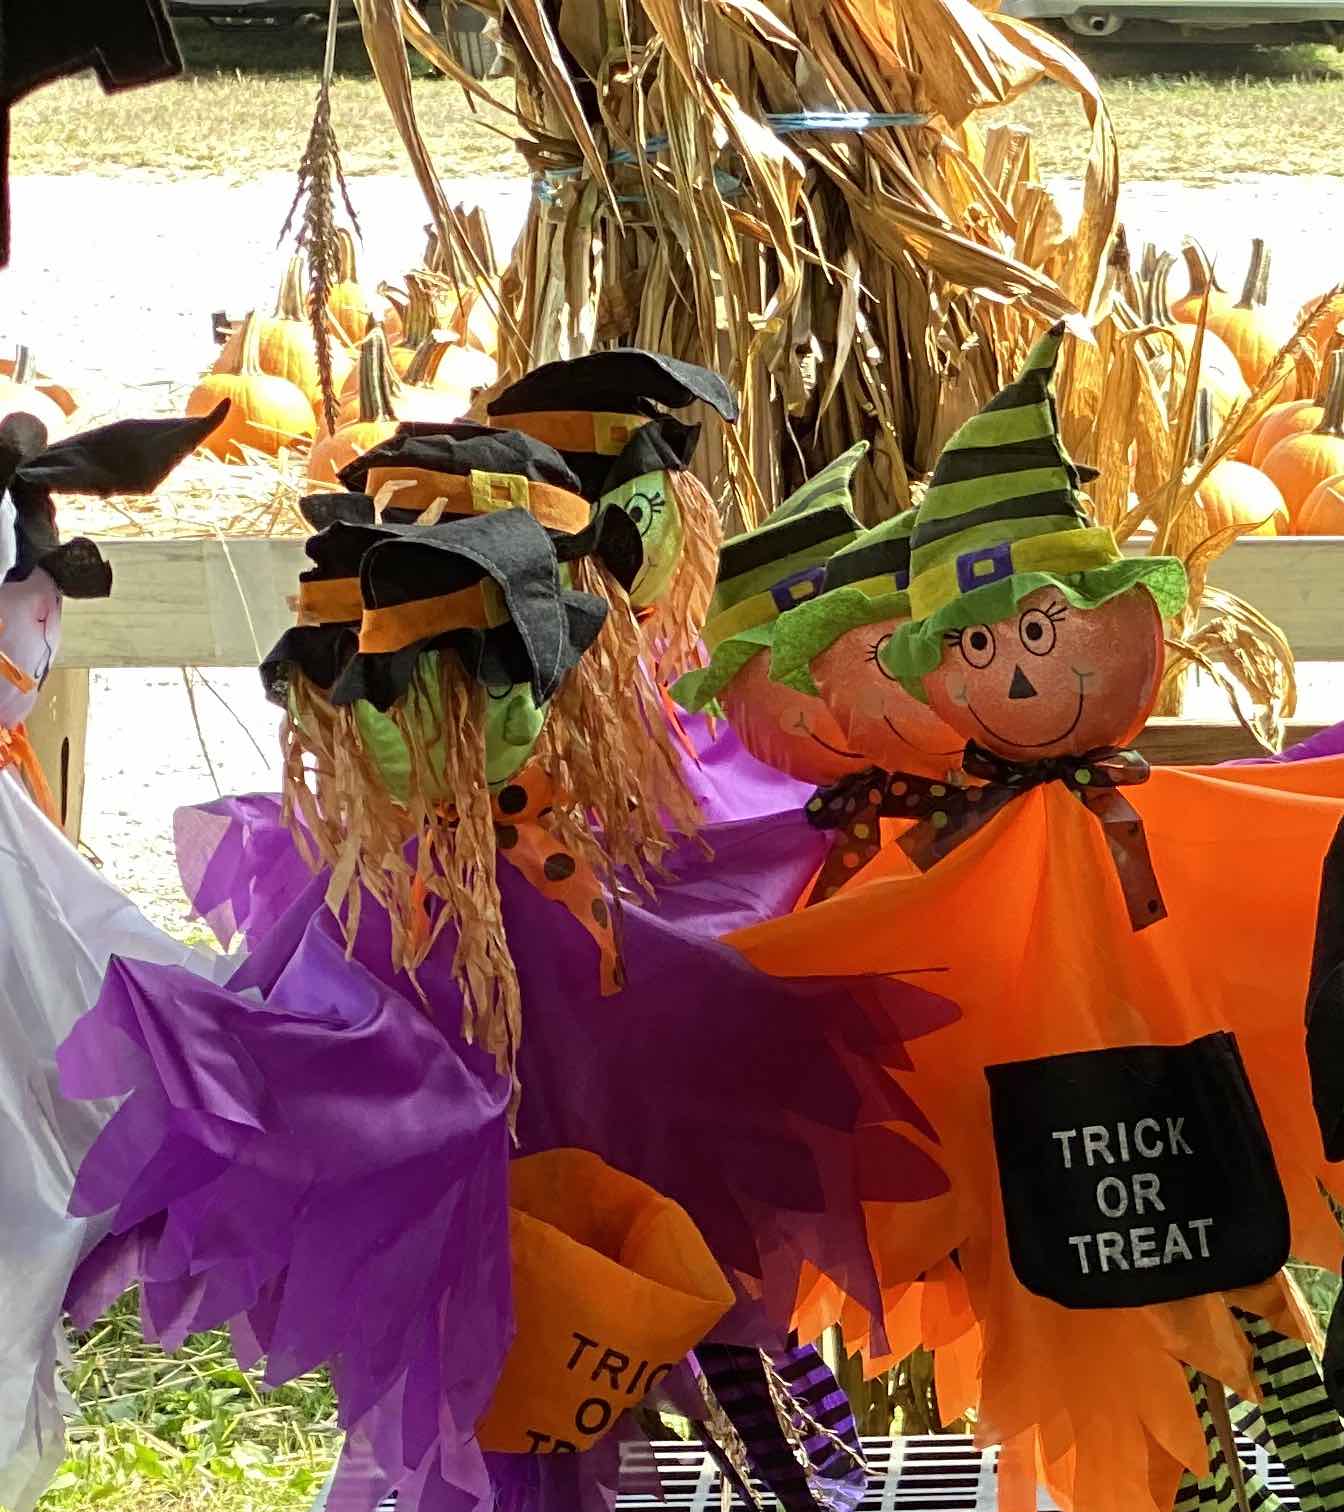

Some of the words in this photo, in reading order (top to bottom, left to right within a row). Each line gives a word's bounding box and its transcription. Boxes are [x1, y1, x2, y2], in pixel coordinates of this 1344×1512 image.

[1052, 1117, 1194, 1169] TRICK
[1096, 1173, 1167, 1218] OR
[1068, 1218, 1214, 1274] TREAT
[566, 1332, 673, 1395] TRIC
